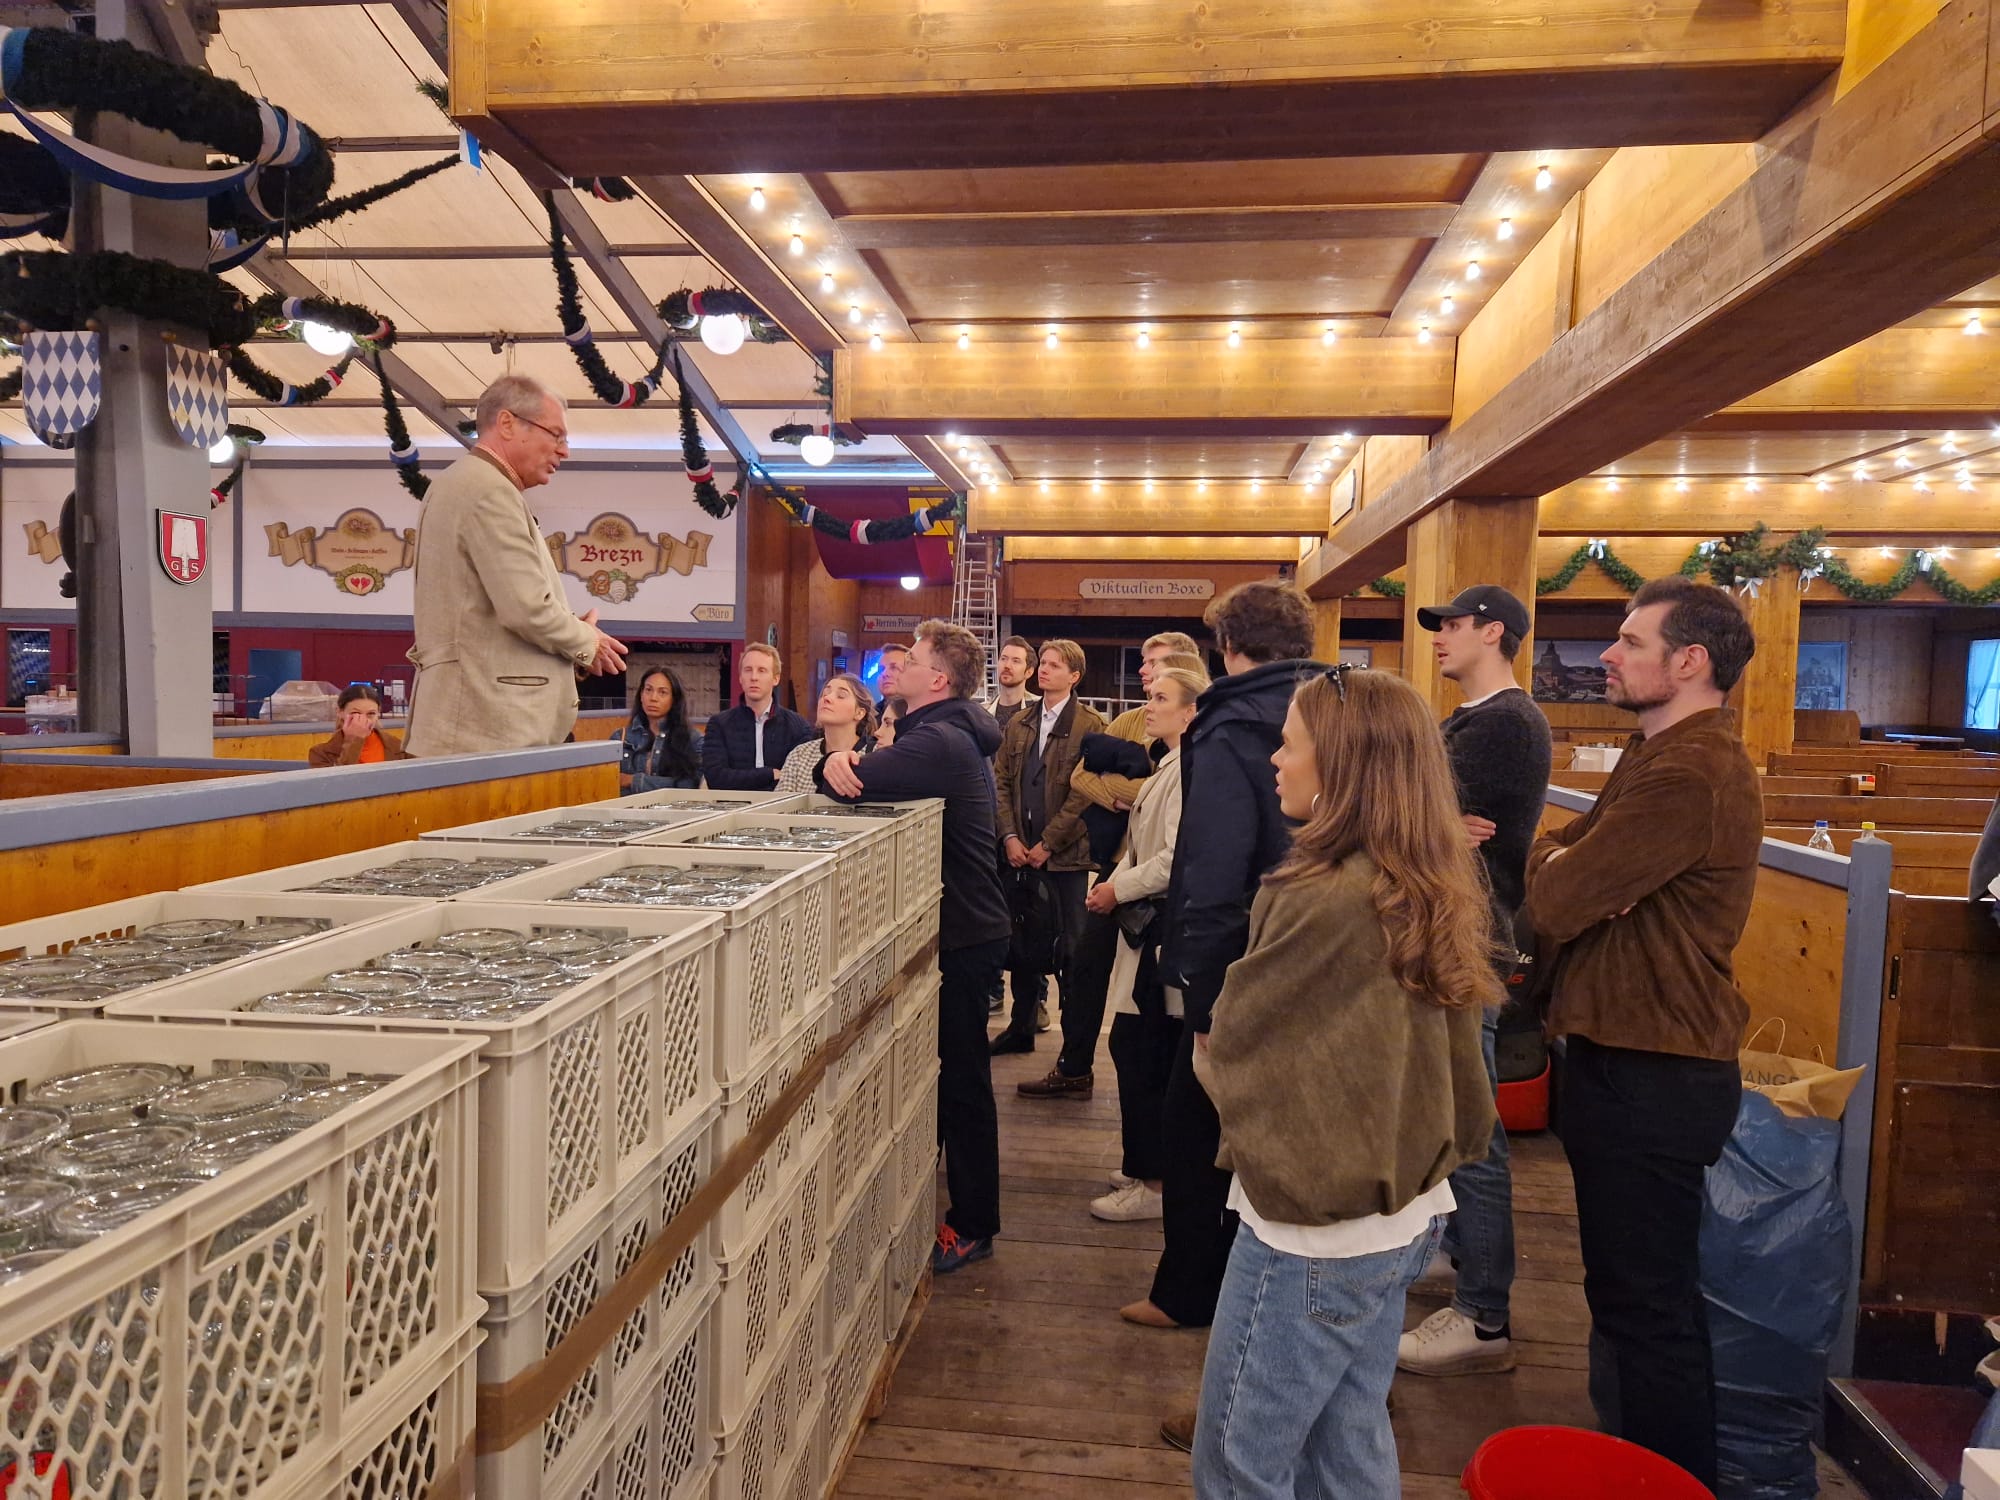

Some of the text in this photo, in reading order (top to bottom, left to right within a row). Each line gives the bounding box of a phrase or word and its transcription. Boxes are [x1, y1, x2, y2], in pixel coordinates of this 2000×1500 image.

[580, 544, 645, 567] Brezn
[190, 562, 199, 573] S
[1090, 581, 1204, 595] Viktualien Boxe
[706, 607, 730, 620] Büro
